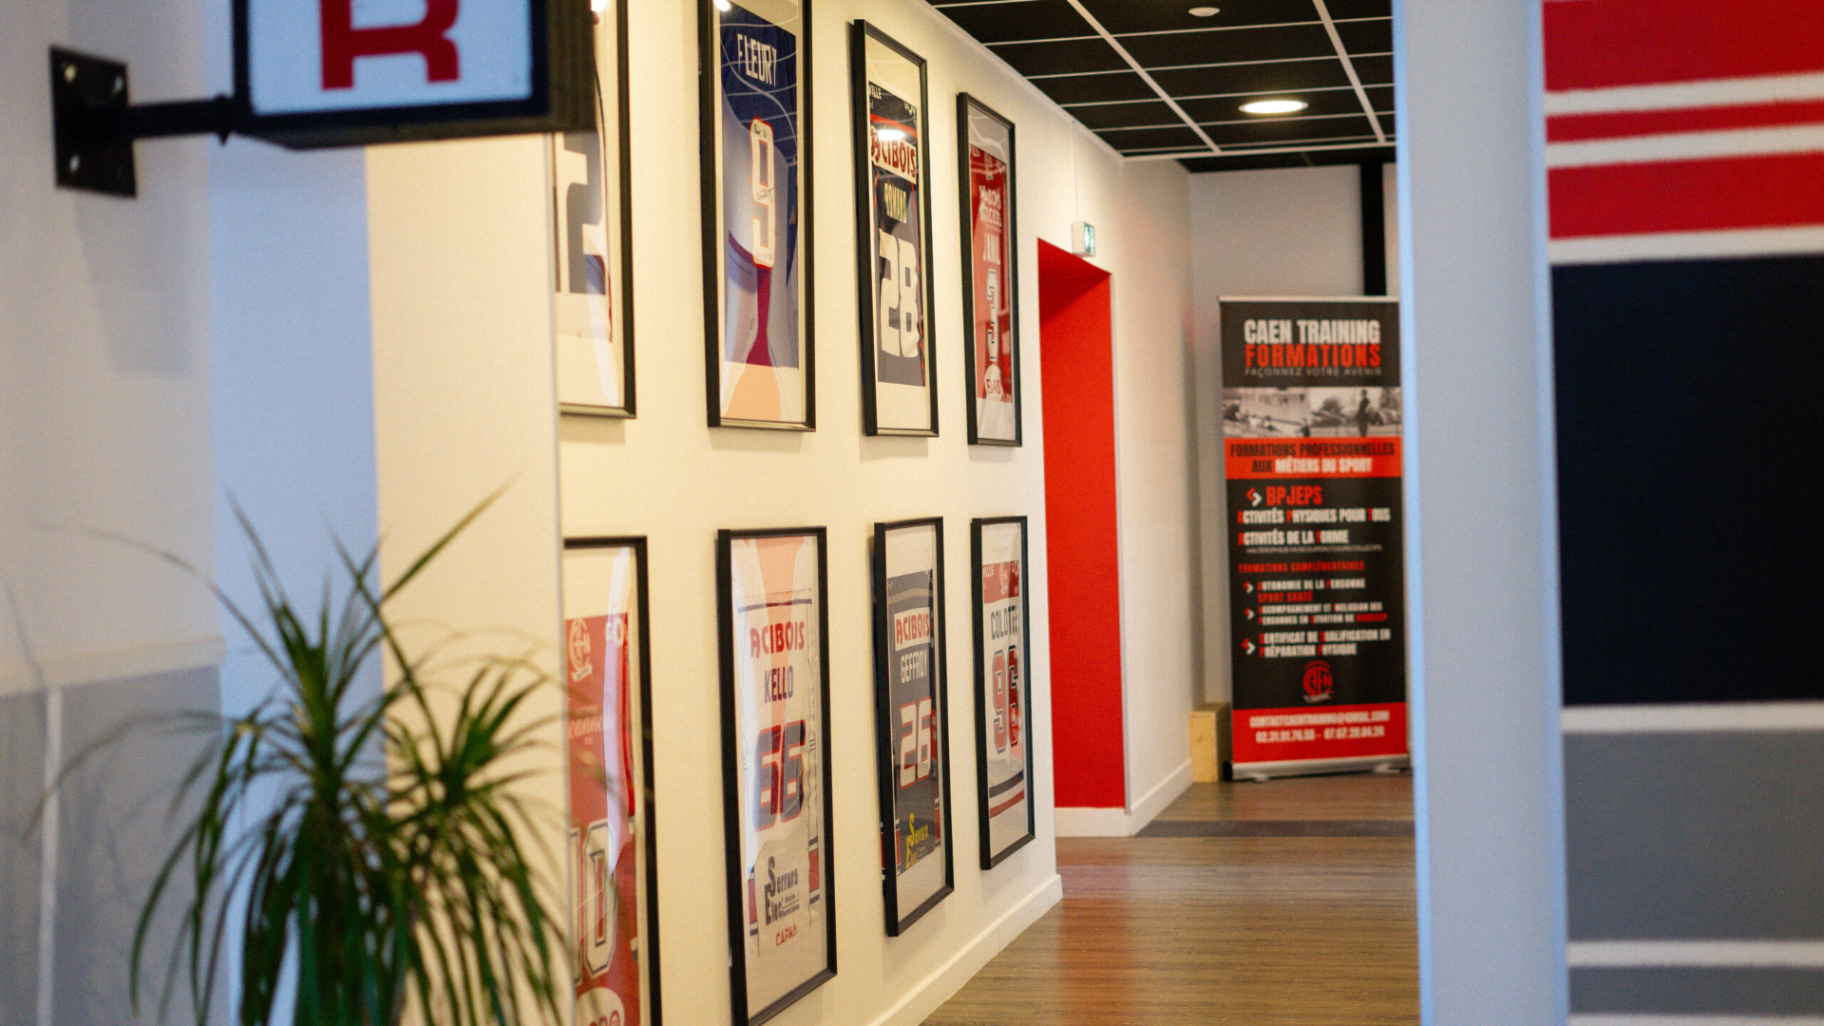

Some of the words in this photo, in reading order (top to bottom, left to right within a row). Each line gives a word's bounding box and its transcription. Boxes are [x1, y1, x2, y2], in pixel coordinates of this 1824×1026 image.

[737, 33, 777, 87] FLEURY
[749, 115, 776, 270] 9
[878, 228, 919, 358] 28
[1244, 319, 1293, 345] CAEN
[1297, 319, 1381, 345] TRAINING
[1245, 344, 1381, 368] FORMATIONS
[1245, 367, 1302, 378] FAÇONNEZ
[1306, 367, 1340, 377] VOTRE
[1344, 366, 1382, 376] AVENIR
[1231, 443, 1297, 457] FORMATIONS
[1299, 442, 1395, 456] PROFESSIONNELLES
[1252, 459, 1272, 473] AUX
[1275, 455, 1320, 474] MÉTIERS
[1321, 458, 1337, 473] DU
[1338, 457, 1373, 473] SPORT
[1266, 485, 1323, 506] BPJEPS
[1237, 507, 1285, 524] ACTIVITÉS
[1286, 508, 1338, 524] PHYSIQUES
[1339, 508, 1366, 523] POUR
[1368, 507, 1391, 523] TOUS
[1238, 528, 1285, 546] ACTIVITÉS
[1286, 530, 1300, 545] DE
[1302, 530, 1315, 545] LA
[1315, 529, 1349, 544] FORME
[1238, 562, 1288, 574] FORMATIONS
[1315, 579, 1325, 590] LA
[1257, 592, 1284, 603] SPORT
[750, 621, 805, 659] ACIBOIS
[896, 613, 930, 645] ACIBOIS
[1307, 631, 1318, 643] DE
[764, 665, 794, 703] KELLO
[900, 696, 932, 790] 26
[753, 719, 806, 832] 66
